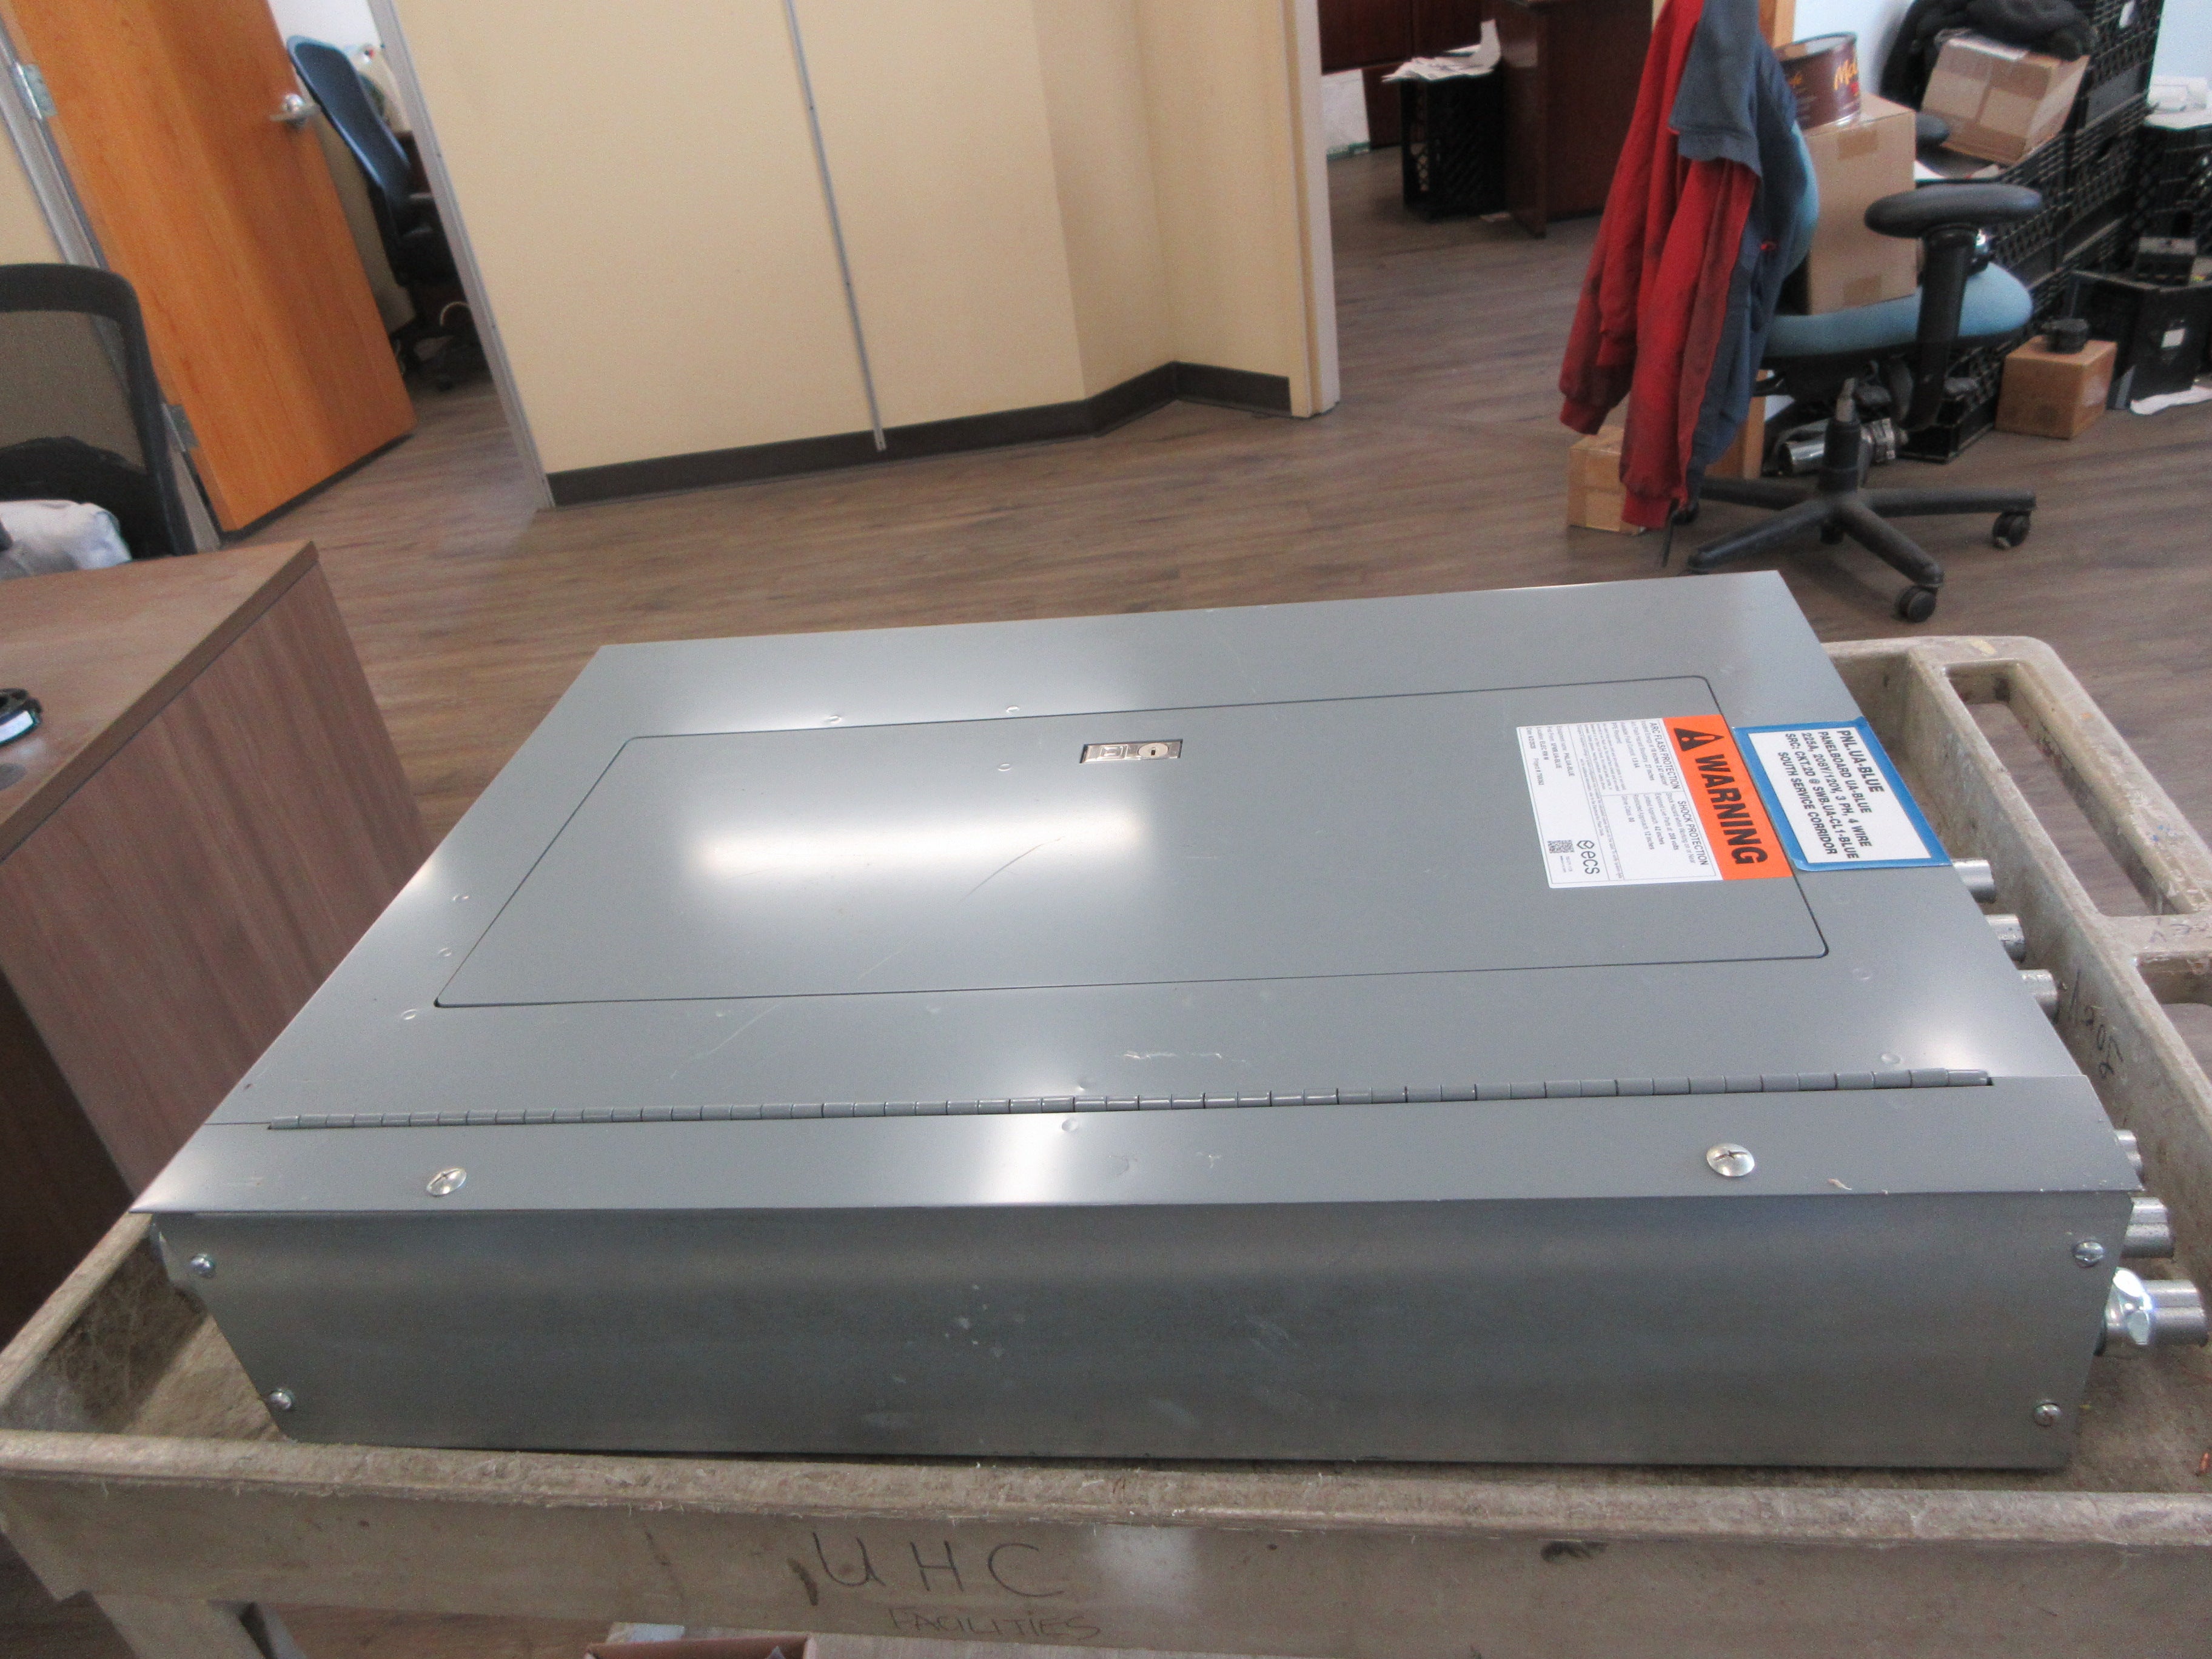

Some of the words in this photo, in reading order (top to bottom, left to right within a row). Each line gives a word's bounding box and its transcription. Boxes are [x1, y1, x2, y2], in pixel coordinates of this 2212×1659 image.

[1649, 722, 1660, 733] ARC
[1653, 734, 1667, 751] FLASH
[1660, 753, 1680, 789] PROTECTION
[1798, 732, 1820, 751] 225A,
[1810, 754, 1843, 793] 208Y/120V,
[1836, 803, 1855, 816] PH,
[1850, 826, 1872, 846] WIRE
[1817, 731, 1853, 777] PANELBOARD
[1843, 780, 1872, 813] UA-BLUE
[1835, 729, 1885, 792] PNL.UA-BLUE
[1692, 753, 1771, 864] WARNING
[1776, 752, 1799, 776] SOUTH
[1789, 777, 1815, 809] SERVICE
[1805, 811, 1838, 854] CORRIDOR
[1784, 733, 1802, 749] SRC:
[1793, 751, 1817, 776] CKT.2D
[1809, 786, 1860, 859] SWB.UA-CL1-BLUE
[1580, 851, 1601, 874] ecs
[1677, 800, 1693, 822] SHOCK
[1685, 824, 1709, 865] PROTECTION
[813, 1532, 1065, 1597] UHC
